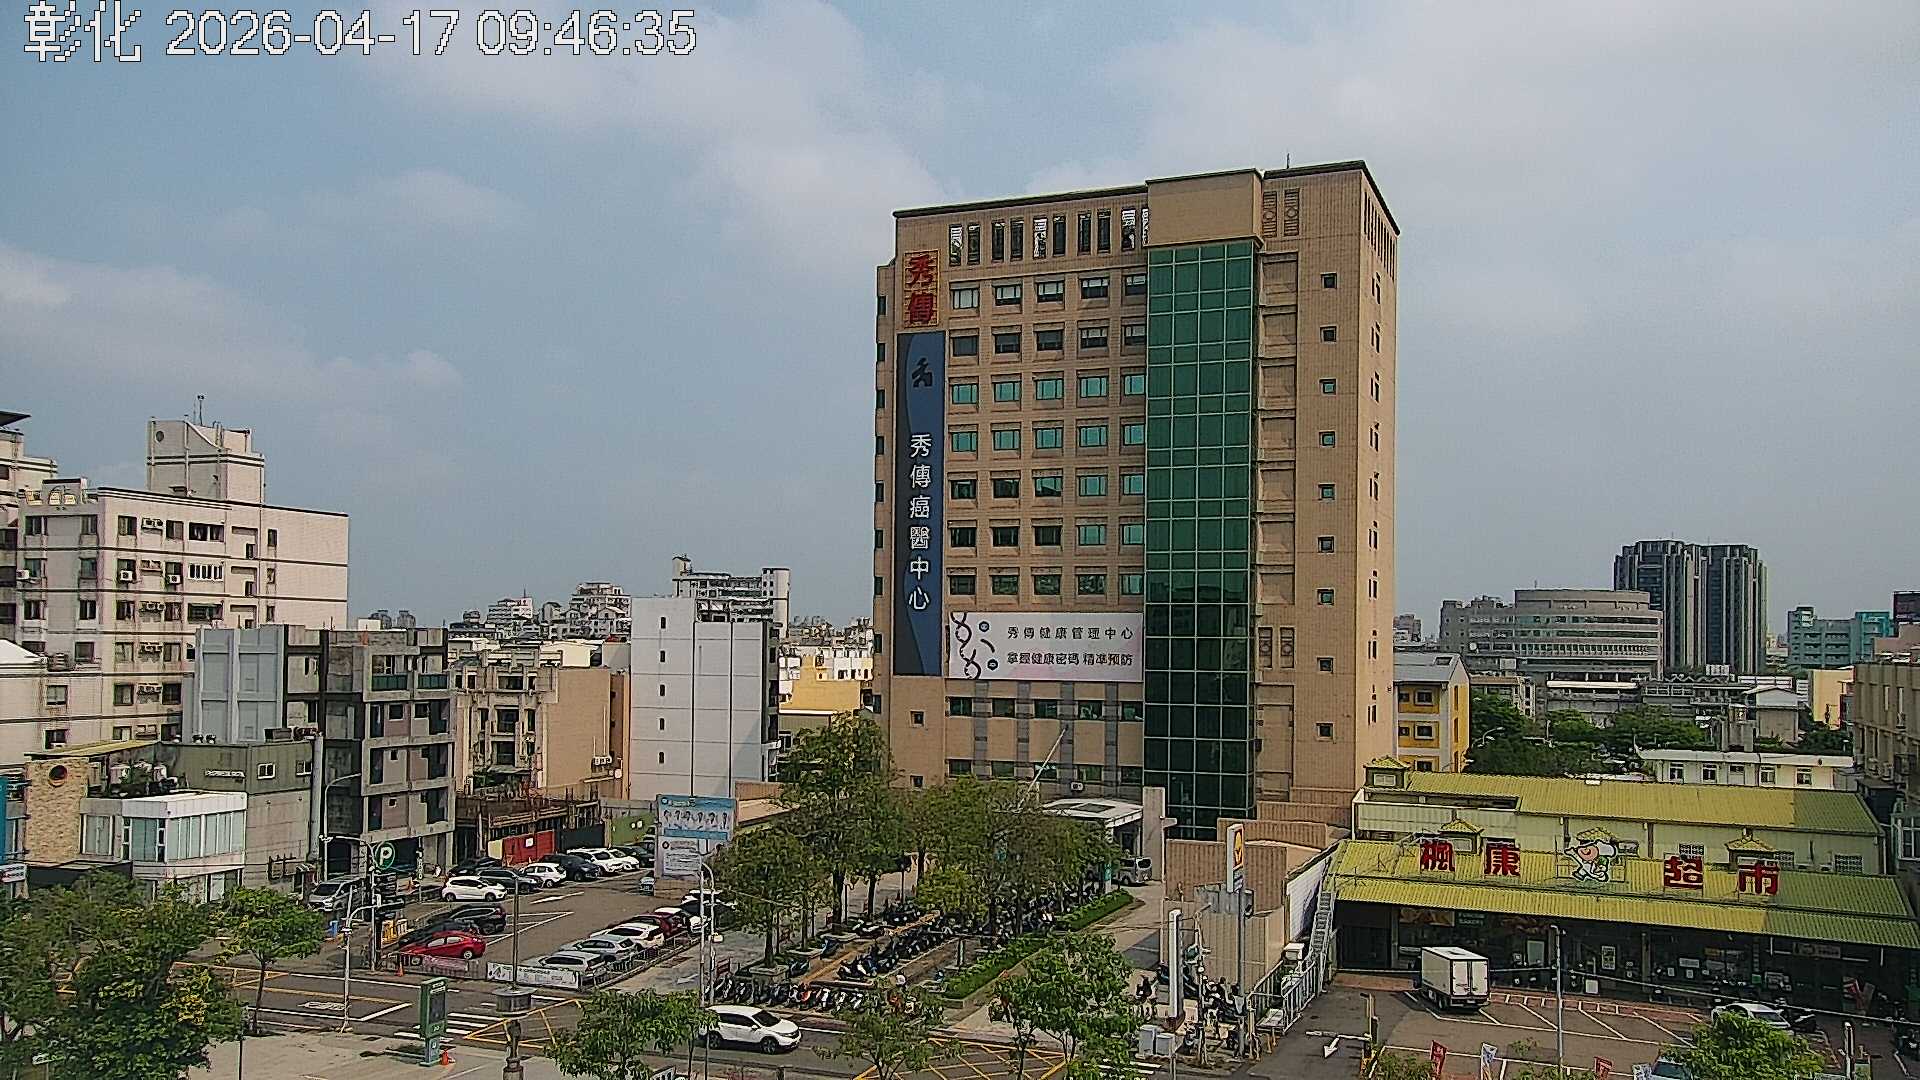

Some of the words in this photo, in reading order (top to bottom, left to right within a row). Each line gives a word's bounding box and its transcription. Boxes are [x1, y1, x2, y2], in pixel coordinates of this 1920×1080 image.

[908, 433, 932, 611] 秀傳癌醫中心
[379, 846, 393, 866] P
[1663, 855, 1780, 896] 超市
